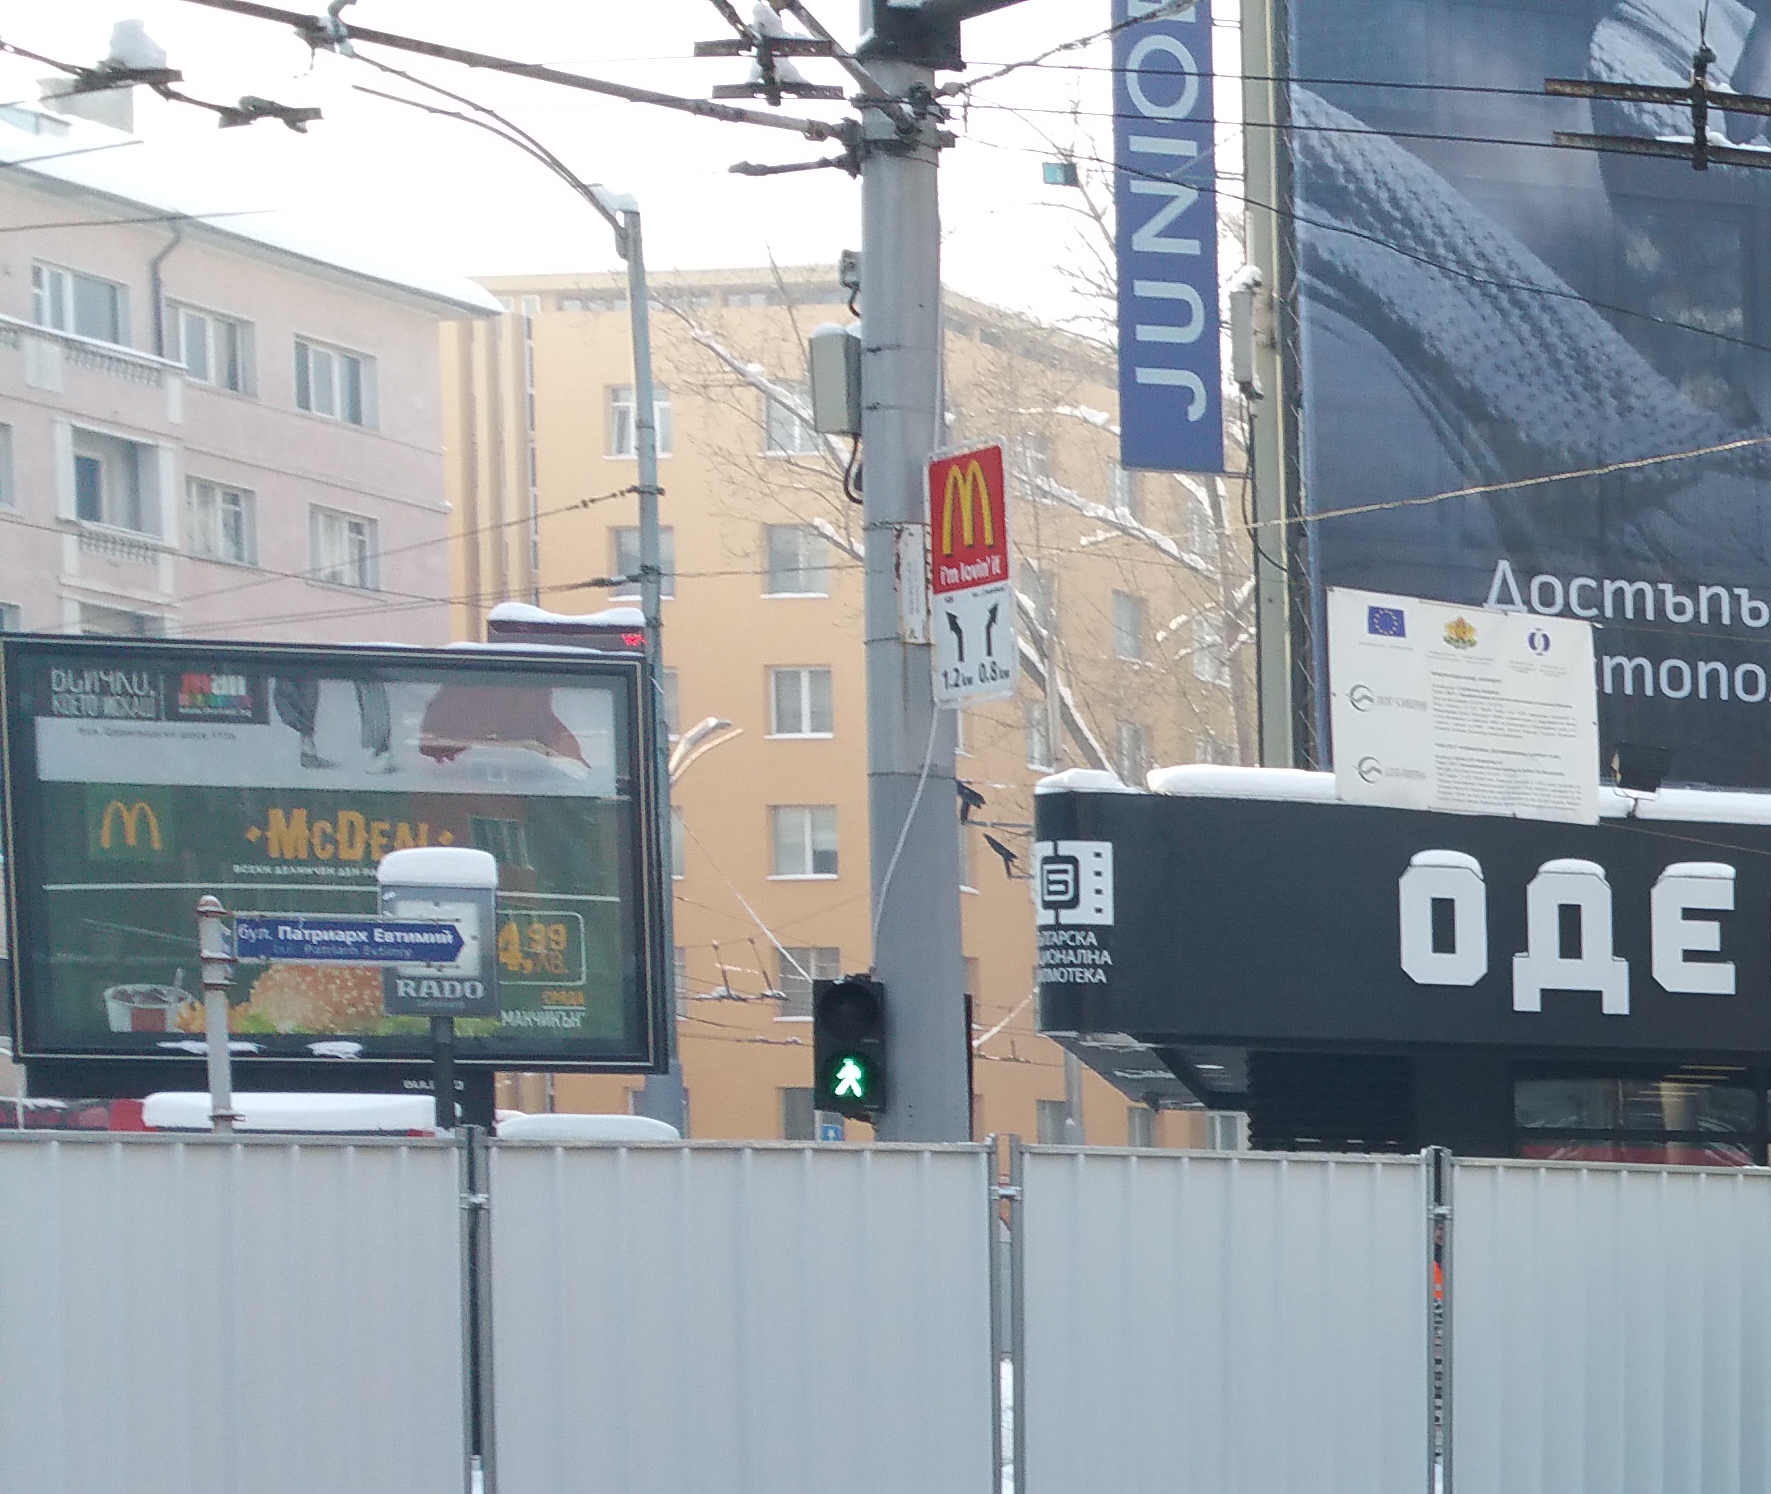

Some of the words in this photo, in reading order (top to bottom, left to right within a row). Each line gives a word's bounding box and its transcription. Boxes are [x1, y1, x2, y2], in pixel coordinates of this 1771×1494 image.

[1126, 0, 1206, 422] JUNIO
[237, 923, 273, 942] бул.
[277, 925, 368, 945] Патриарх
[372, 927, 454, 945] Евтимий
[396, 979, 485, 1000] RADO
